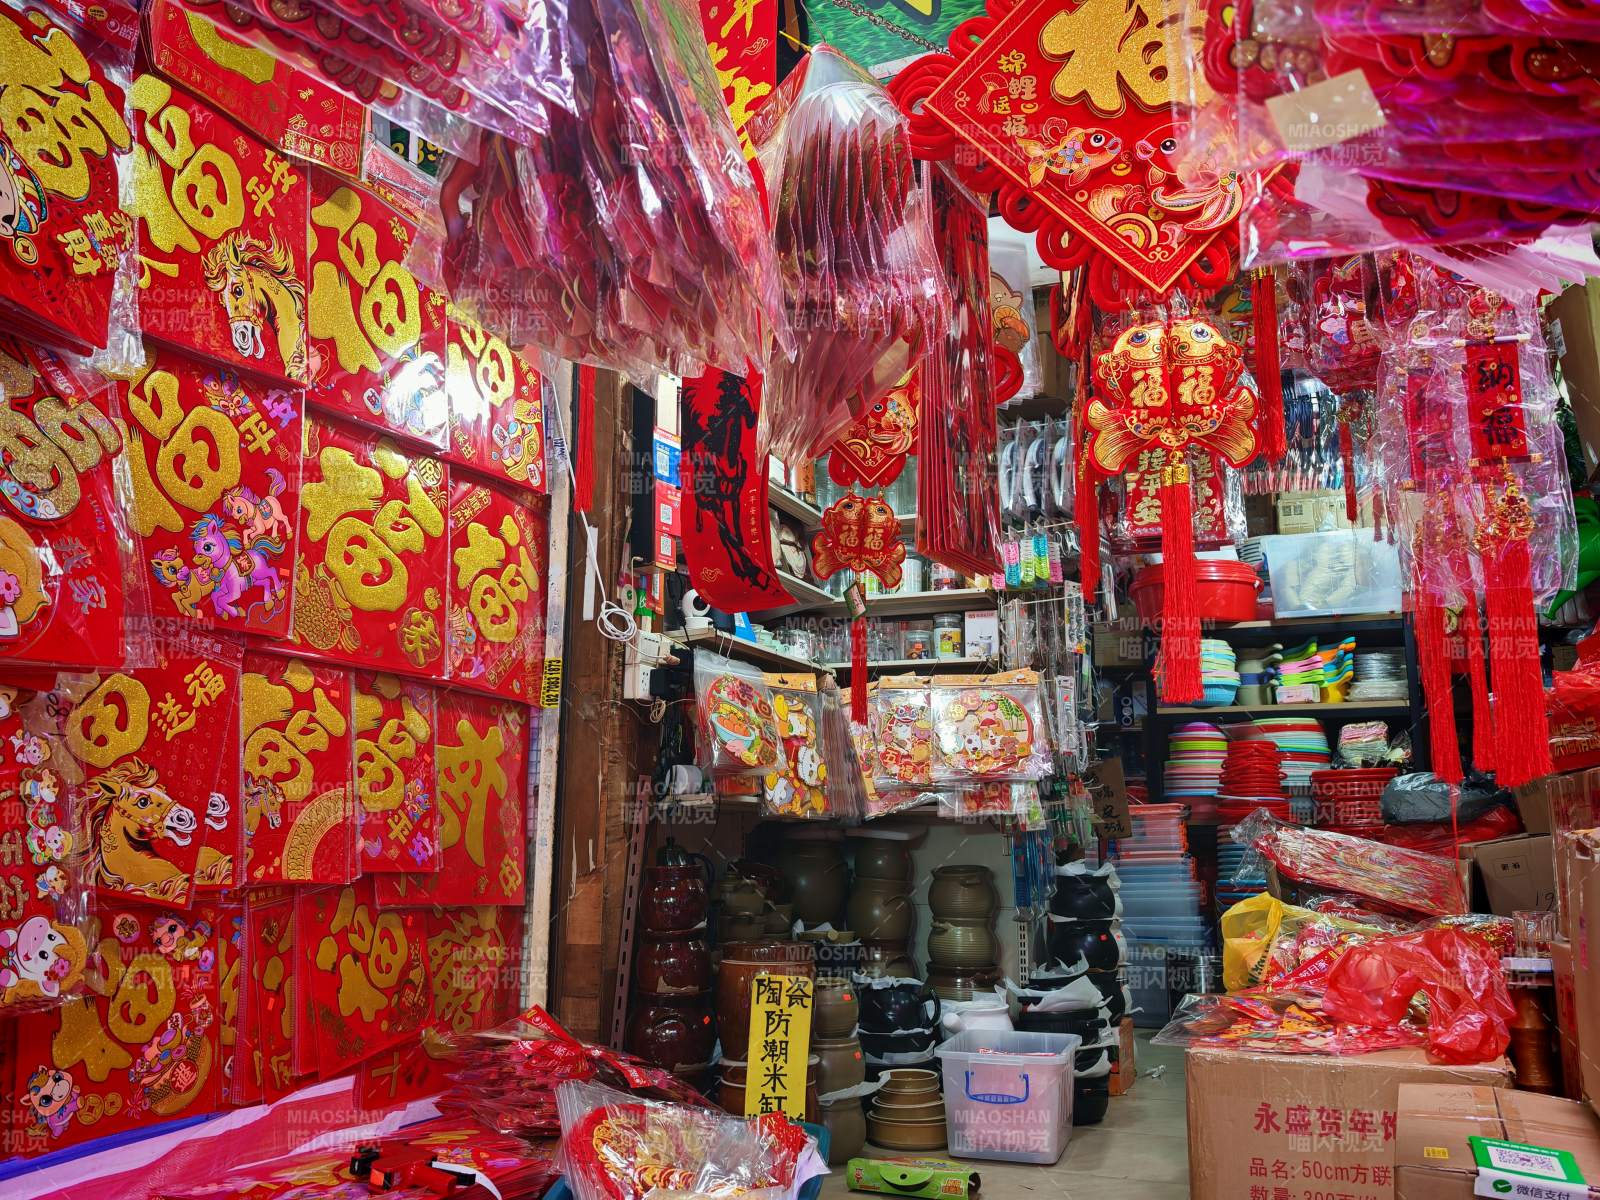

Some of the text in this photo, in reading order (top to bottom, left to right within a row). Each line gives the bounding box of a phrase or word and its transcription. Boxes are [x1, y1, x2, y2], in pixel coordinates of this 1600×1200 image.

[1130, 366, 1216, 408] 福 福
[301, 437, 445, 612] 福
[840, 525, 884, 550] 福 福
[755, 977, 813, 1009] 陶瓷
[758, 1010, 790, 1117] 防潮米缸
[1302, 1160, 1392, 1187] 50cm方联
[1516, 1184, 1570, 1200] 微信支付
